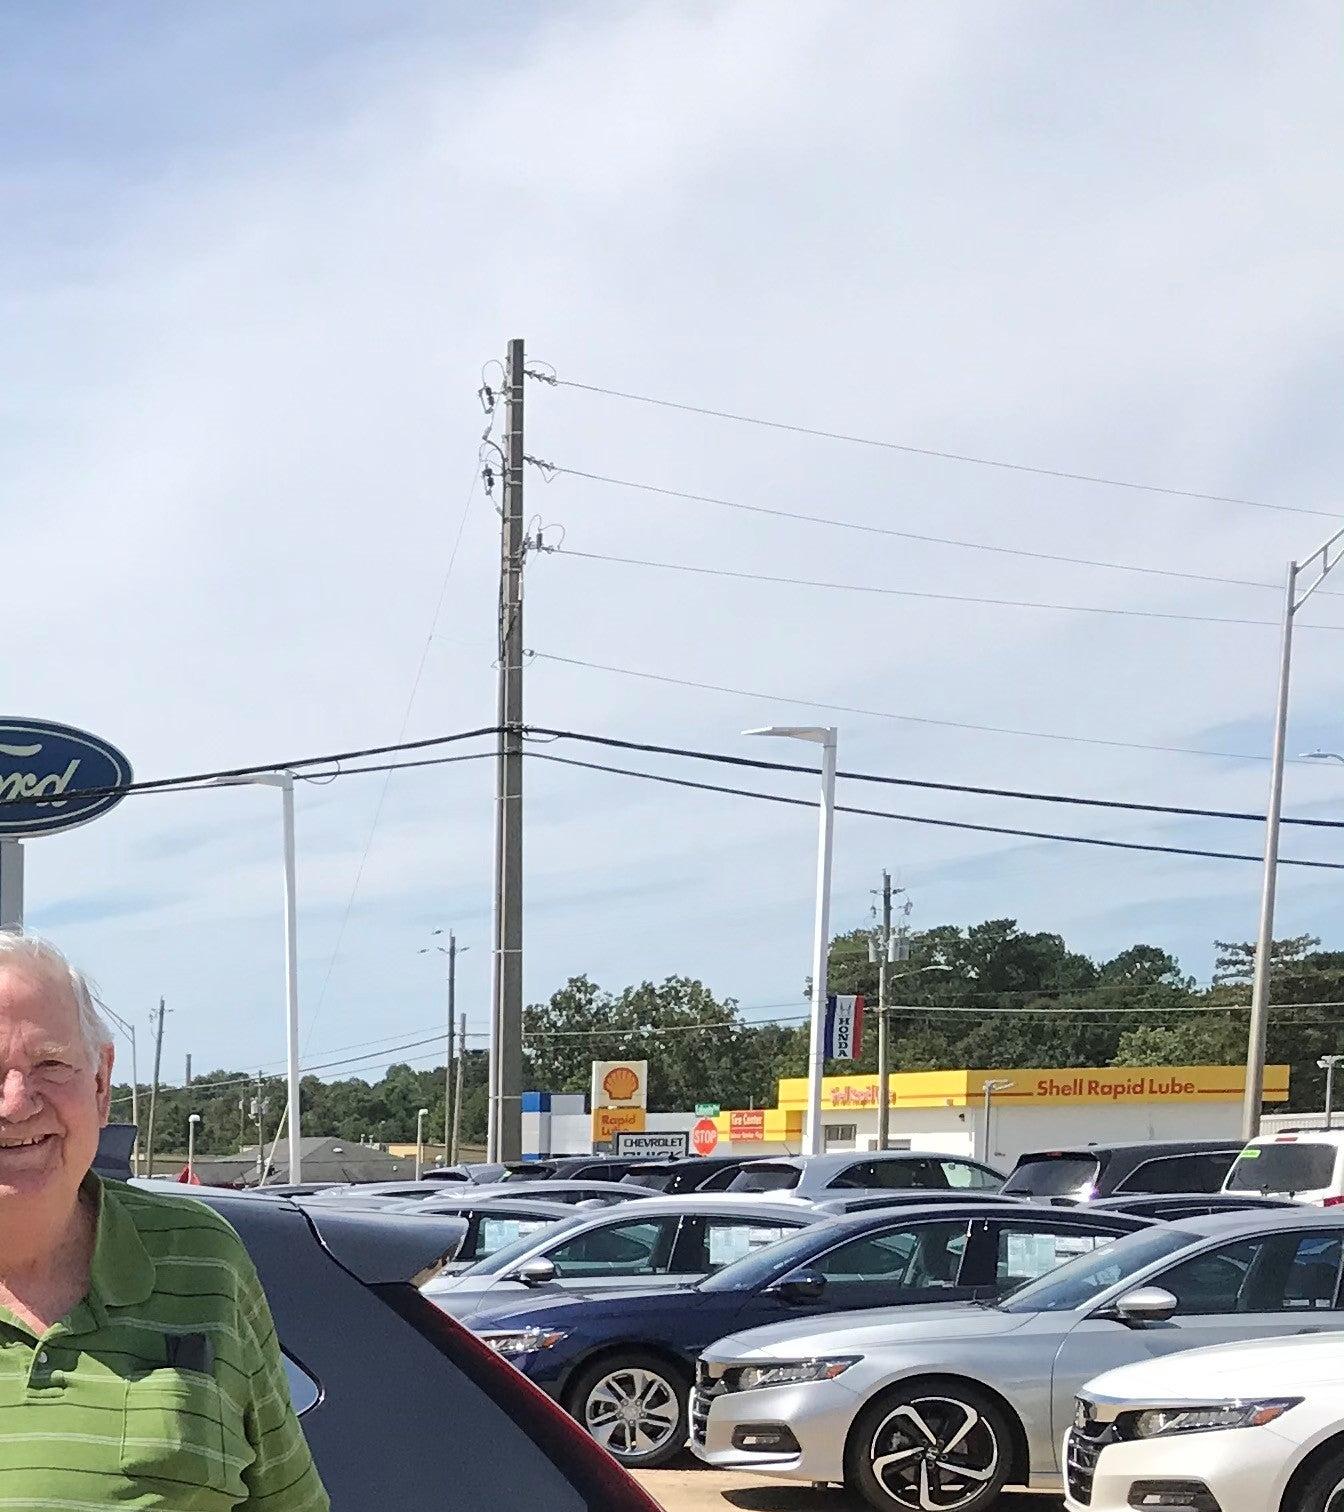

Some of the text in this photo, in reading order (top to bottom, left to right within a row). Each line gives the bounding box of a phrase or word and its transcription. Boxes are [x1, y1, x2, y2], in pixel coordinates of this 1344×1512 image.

[837, 1017, 851, 1057] HONDA
[1037, 1077, 1195, 1099] Shell Rapid Lube
[601, 1113, 636, 1130] Rapid
[623, 1137, 684, 1148] CHEVROLET
[694, 1130, 717, 1143] STOP
